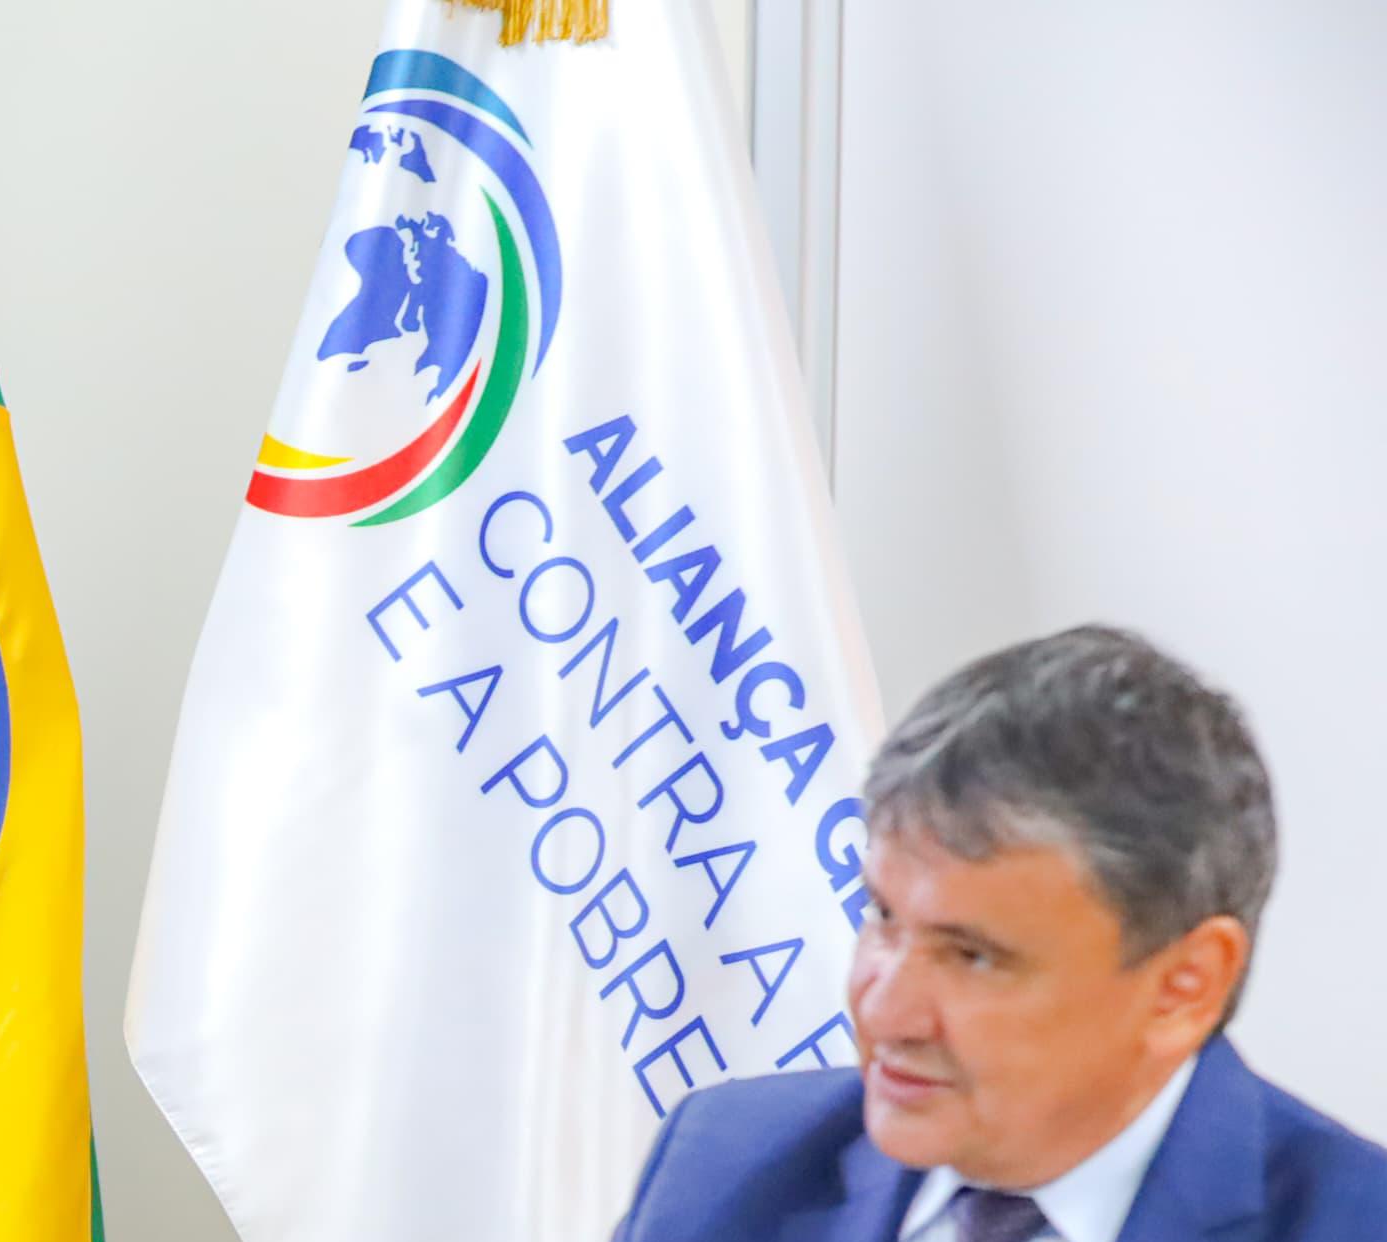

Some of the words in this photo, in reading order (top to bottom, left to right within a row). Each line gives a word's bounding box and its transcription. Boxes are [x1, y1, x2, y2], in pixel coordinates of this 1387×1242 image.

[365, 560, 465, 662] E
[416, 663, 504, 754] A
[479, 734, 727, 1119] POBRE
[478, 490, 758, 930] CONTRA
[719, 938, 805, 1028] A
[562, 414, 836, 806] ALIANÇA
